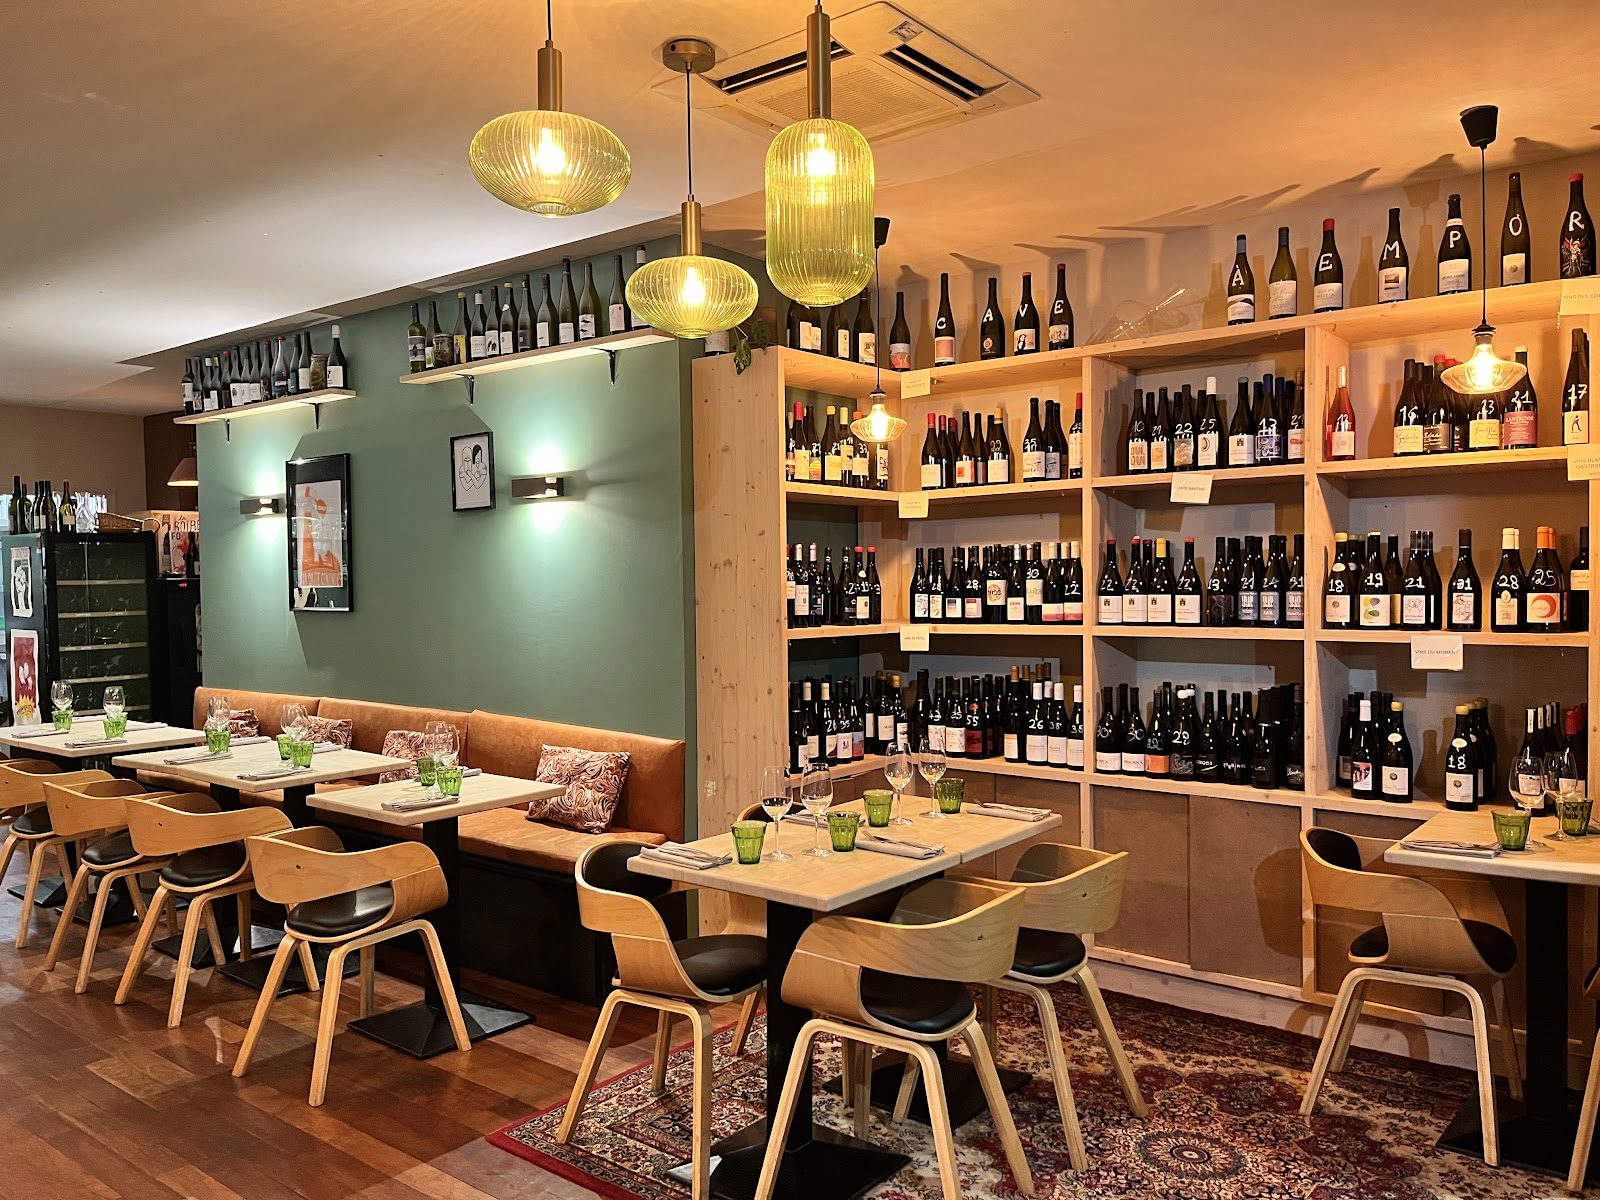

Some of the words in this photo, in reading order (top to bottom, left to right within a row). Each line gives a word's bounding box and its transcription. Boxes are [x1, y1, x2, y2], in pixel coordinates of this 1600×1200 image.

[1328, 578, 1345, 593] 18
[1499, 575, 1519, 589] 28
[1448, 754, 1467, 770] 18
